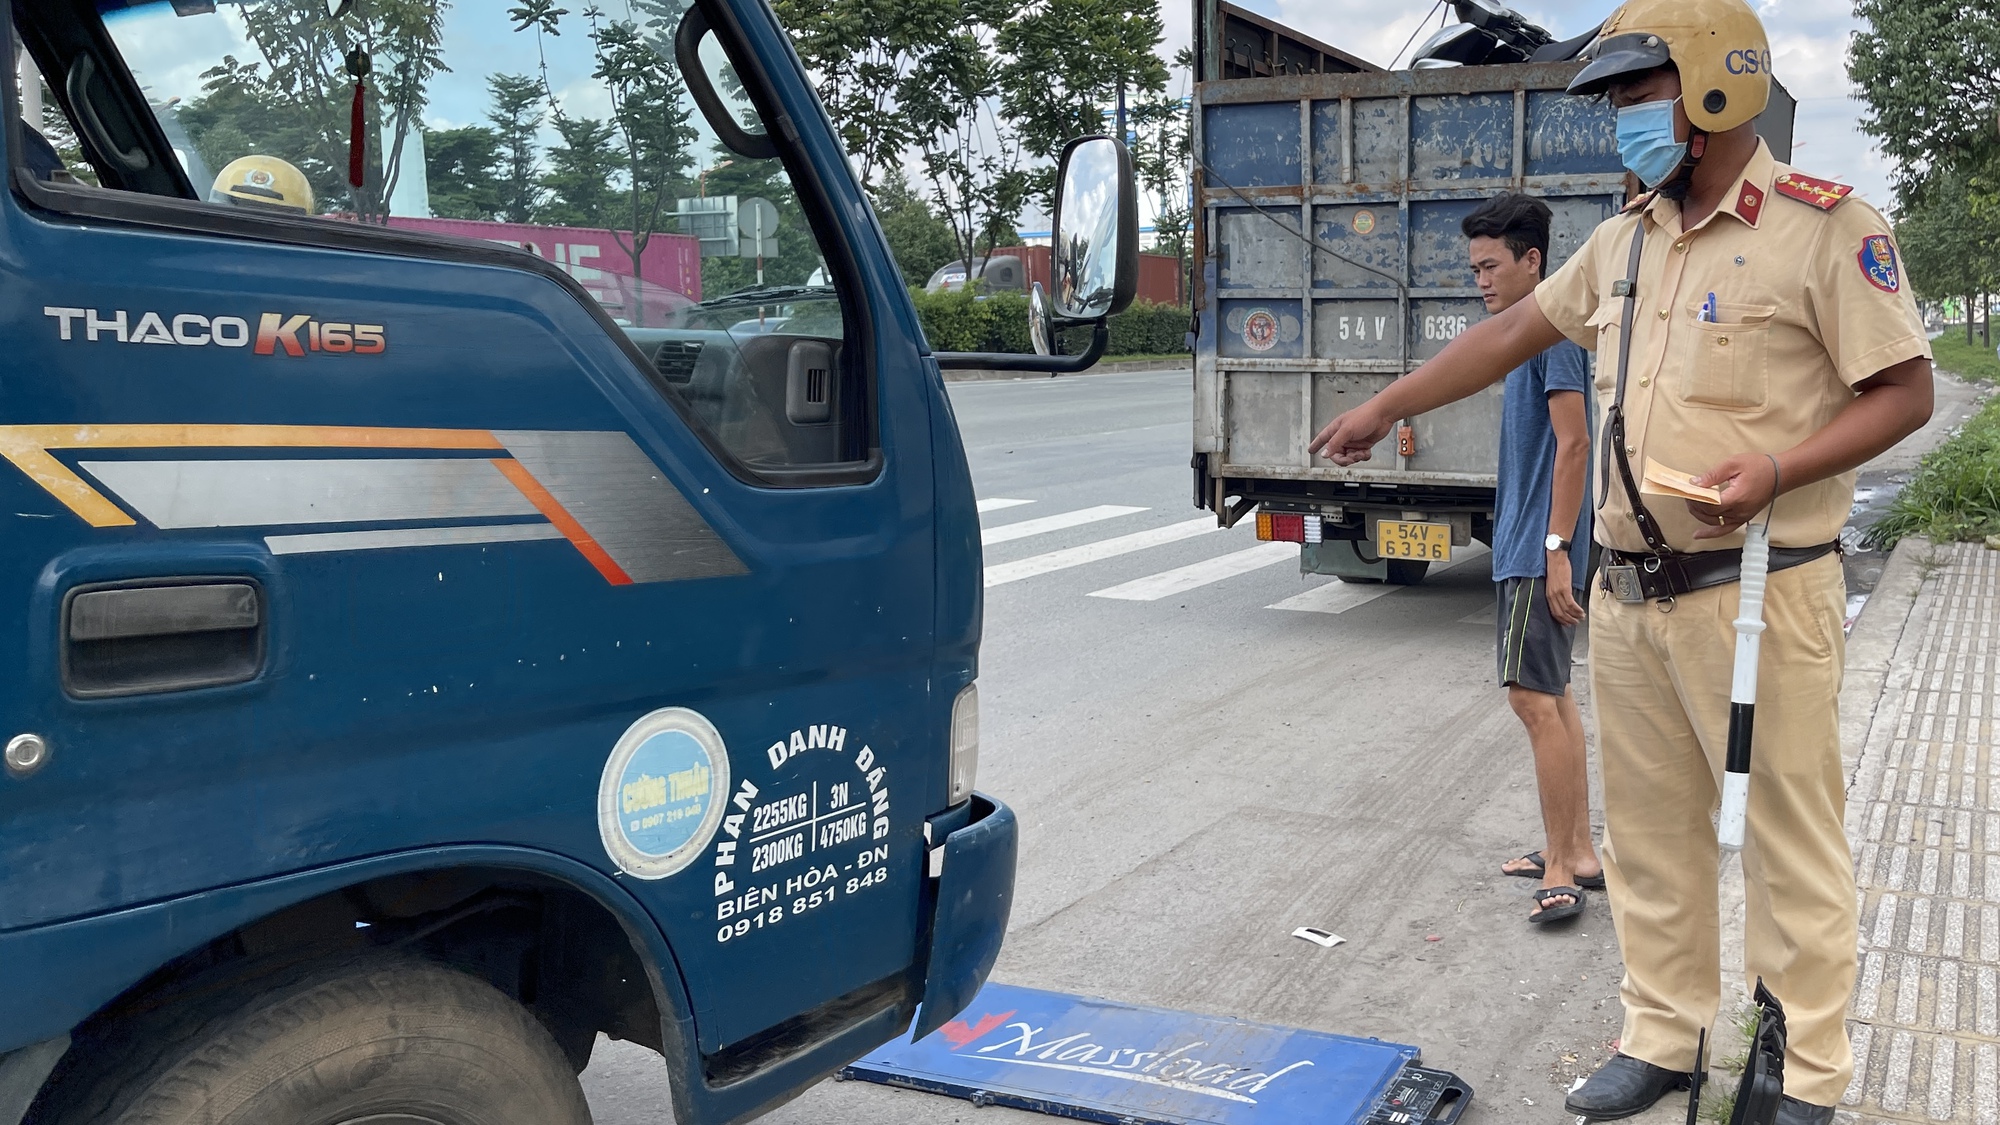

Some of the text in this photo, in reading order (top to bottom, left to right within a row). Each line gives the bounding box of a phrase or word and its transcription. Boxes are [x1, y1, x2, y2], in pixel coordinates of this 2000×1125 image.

[44, 306, 385, 357] THACO K165
[1425, 315, 1467, 340] 6336
[1386, 540, 1442, 558] 6336
[1398, 524, 1429, 540] 54V
[642, 812, 664, 829] 0907
[714, 724, 890, 897] PHAN DANH ĐÁNG
[753, 781, 848, 833] 2255KG 3N
[752, 812, 867, 873] 2300KG 4750KG
[717, 883, 778, 921] BIÊN
[786, 864, 839, 895] HÒA
[857, 844, 888, 868] ĐN
[717, 867, 887, 943] 0918 851 848
[977, 1021, 1315, 1094] Massload
